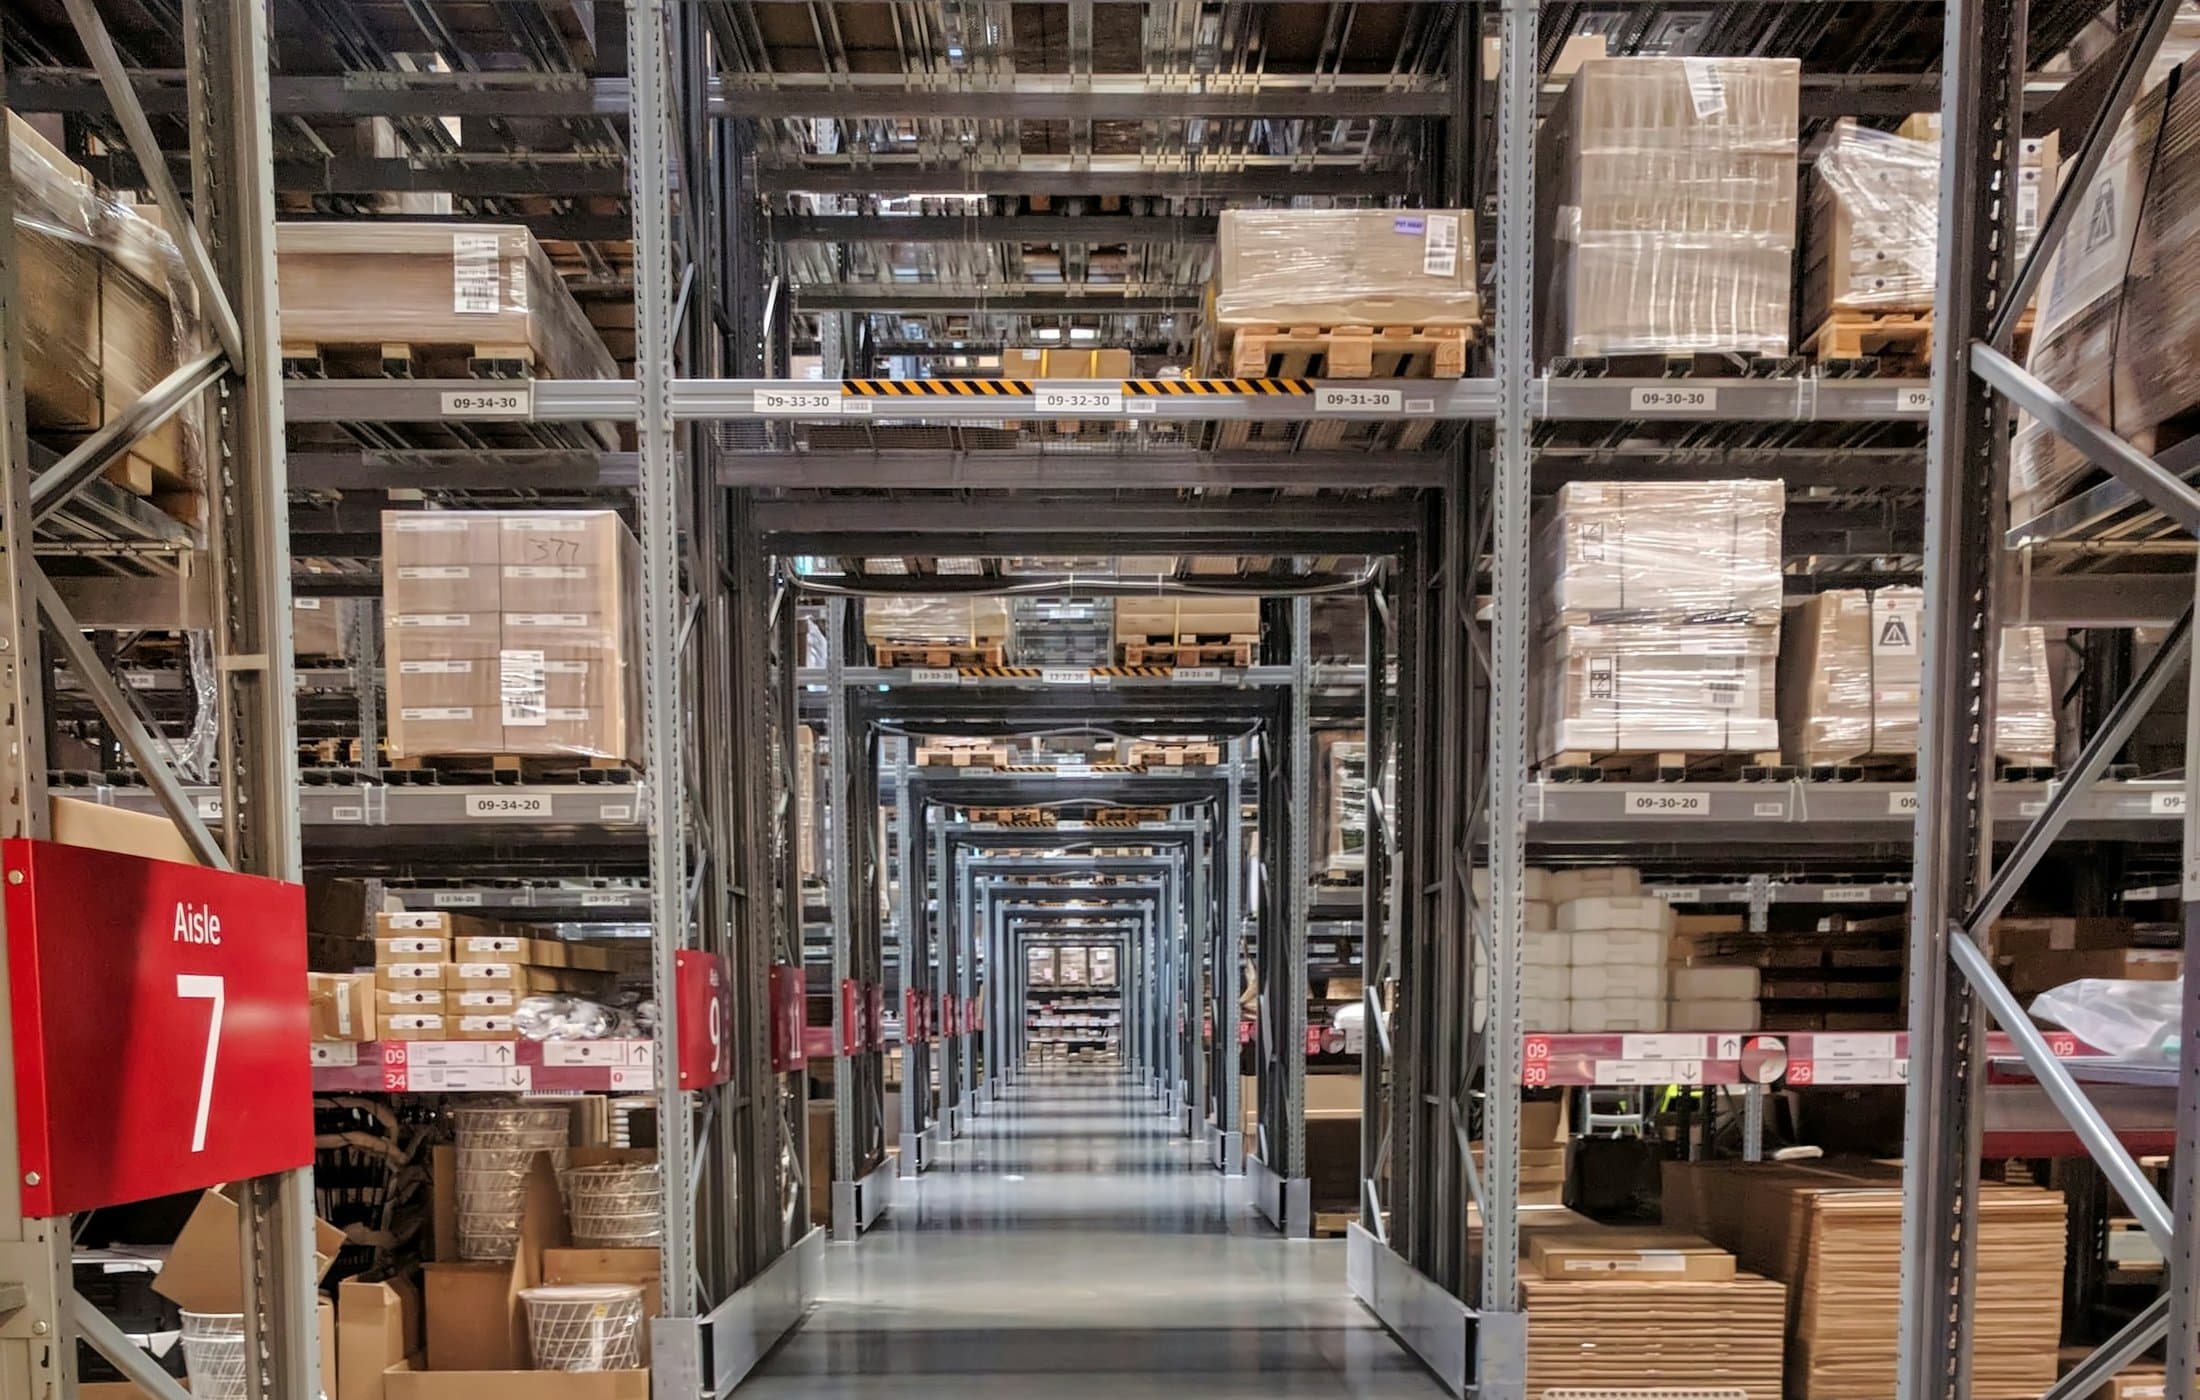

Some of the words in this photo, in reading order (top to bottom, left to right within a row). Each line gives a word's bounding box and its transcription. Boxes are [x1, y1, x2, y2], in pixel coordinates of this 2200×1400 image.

[453, 397, 517, 409] 09-34-30
[767, 396, 830, 407] 09-33-30
[1047, 395, 1110, 406] 09-32-30
[1327, 394, 1390, 405] 09-31-30
[1642, 393, 1705, 405] 09-30-30
[527, 538, 579, 565] 377
[478, 800, 540, 810] 09-34-20
[1636, 797, 1698, 808] 09-30-20
[173, 902, 222, 946] Aisle
[709, 997, 720, 1072] 9
[1527, 1043, 1548, 1058] 09
[2054, 1041, 2074, 1056] 09
[176, 974, 224, 1152] 7
[385, 1049, 405, 1065] 09
[1525, 1068, 1546, 1082] 30
[1790, 1066, 1810, 1081] 29
[385, 1074, 406, 1089] 34
